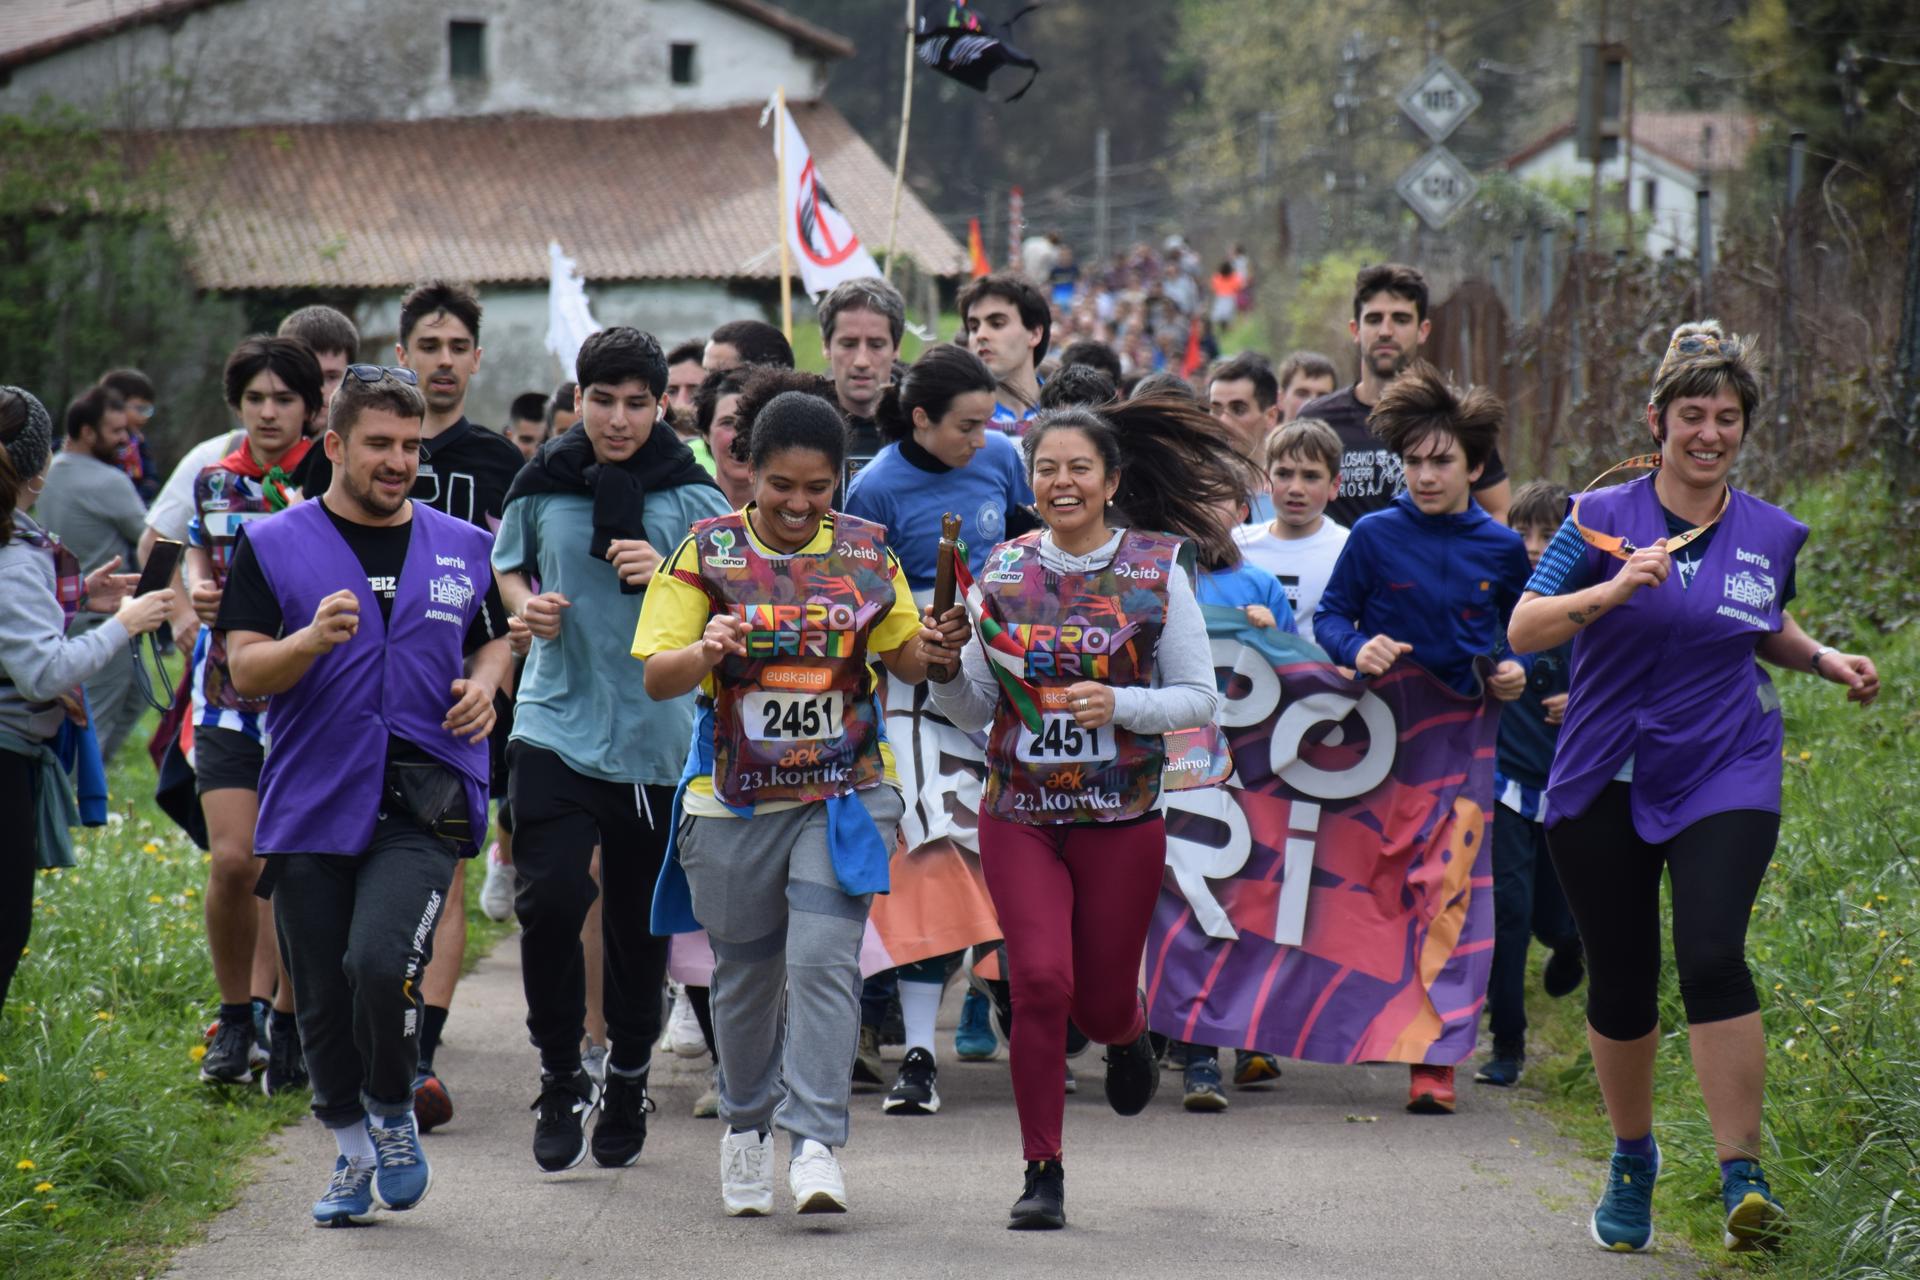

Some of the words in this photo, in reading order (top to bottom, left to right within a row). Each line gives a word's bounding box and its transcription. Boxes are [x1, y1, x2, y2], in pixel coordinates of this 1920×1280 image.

[435, 554, 466, 570] berria
[853, 546, 878, 561] eitb
[1735, 548, 1770, 570] berria
[1131, 567, 1160, 580] eitb
[746, 631, 856, 659] ERRI
[766, 671, 826, 685] euskaltel
[762, 697, 833, 738] 2451
[1028, 718, 1100, 757] 2451
[779, 741, 823, 768] aek
[1045, 764, 1086, 789] aek
